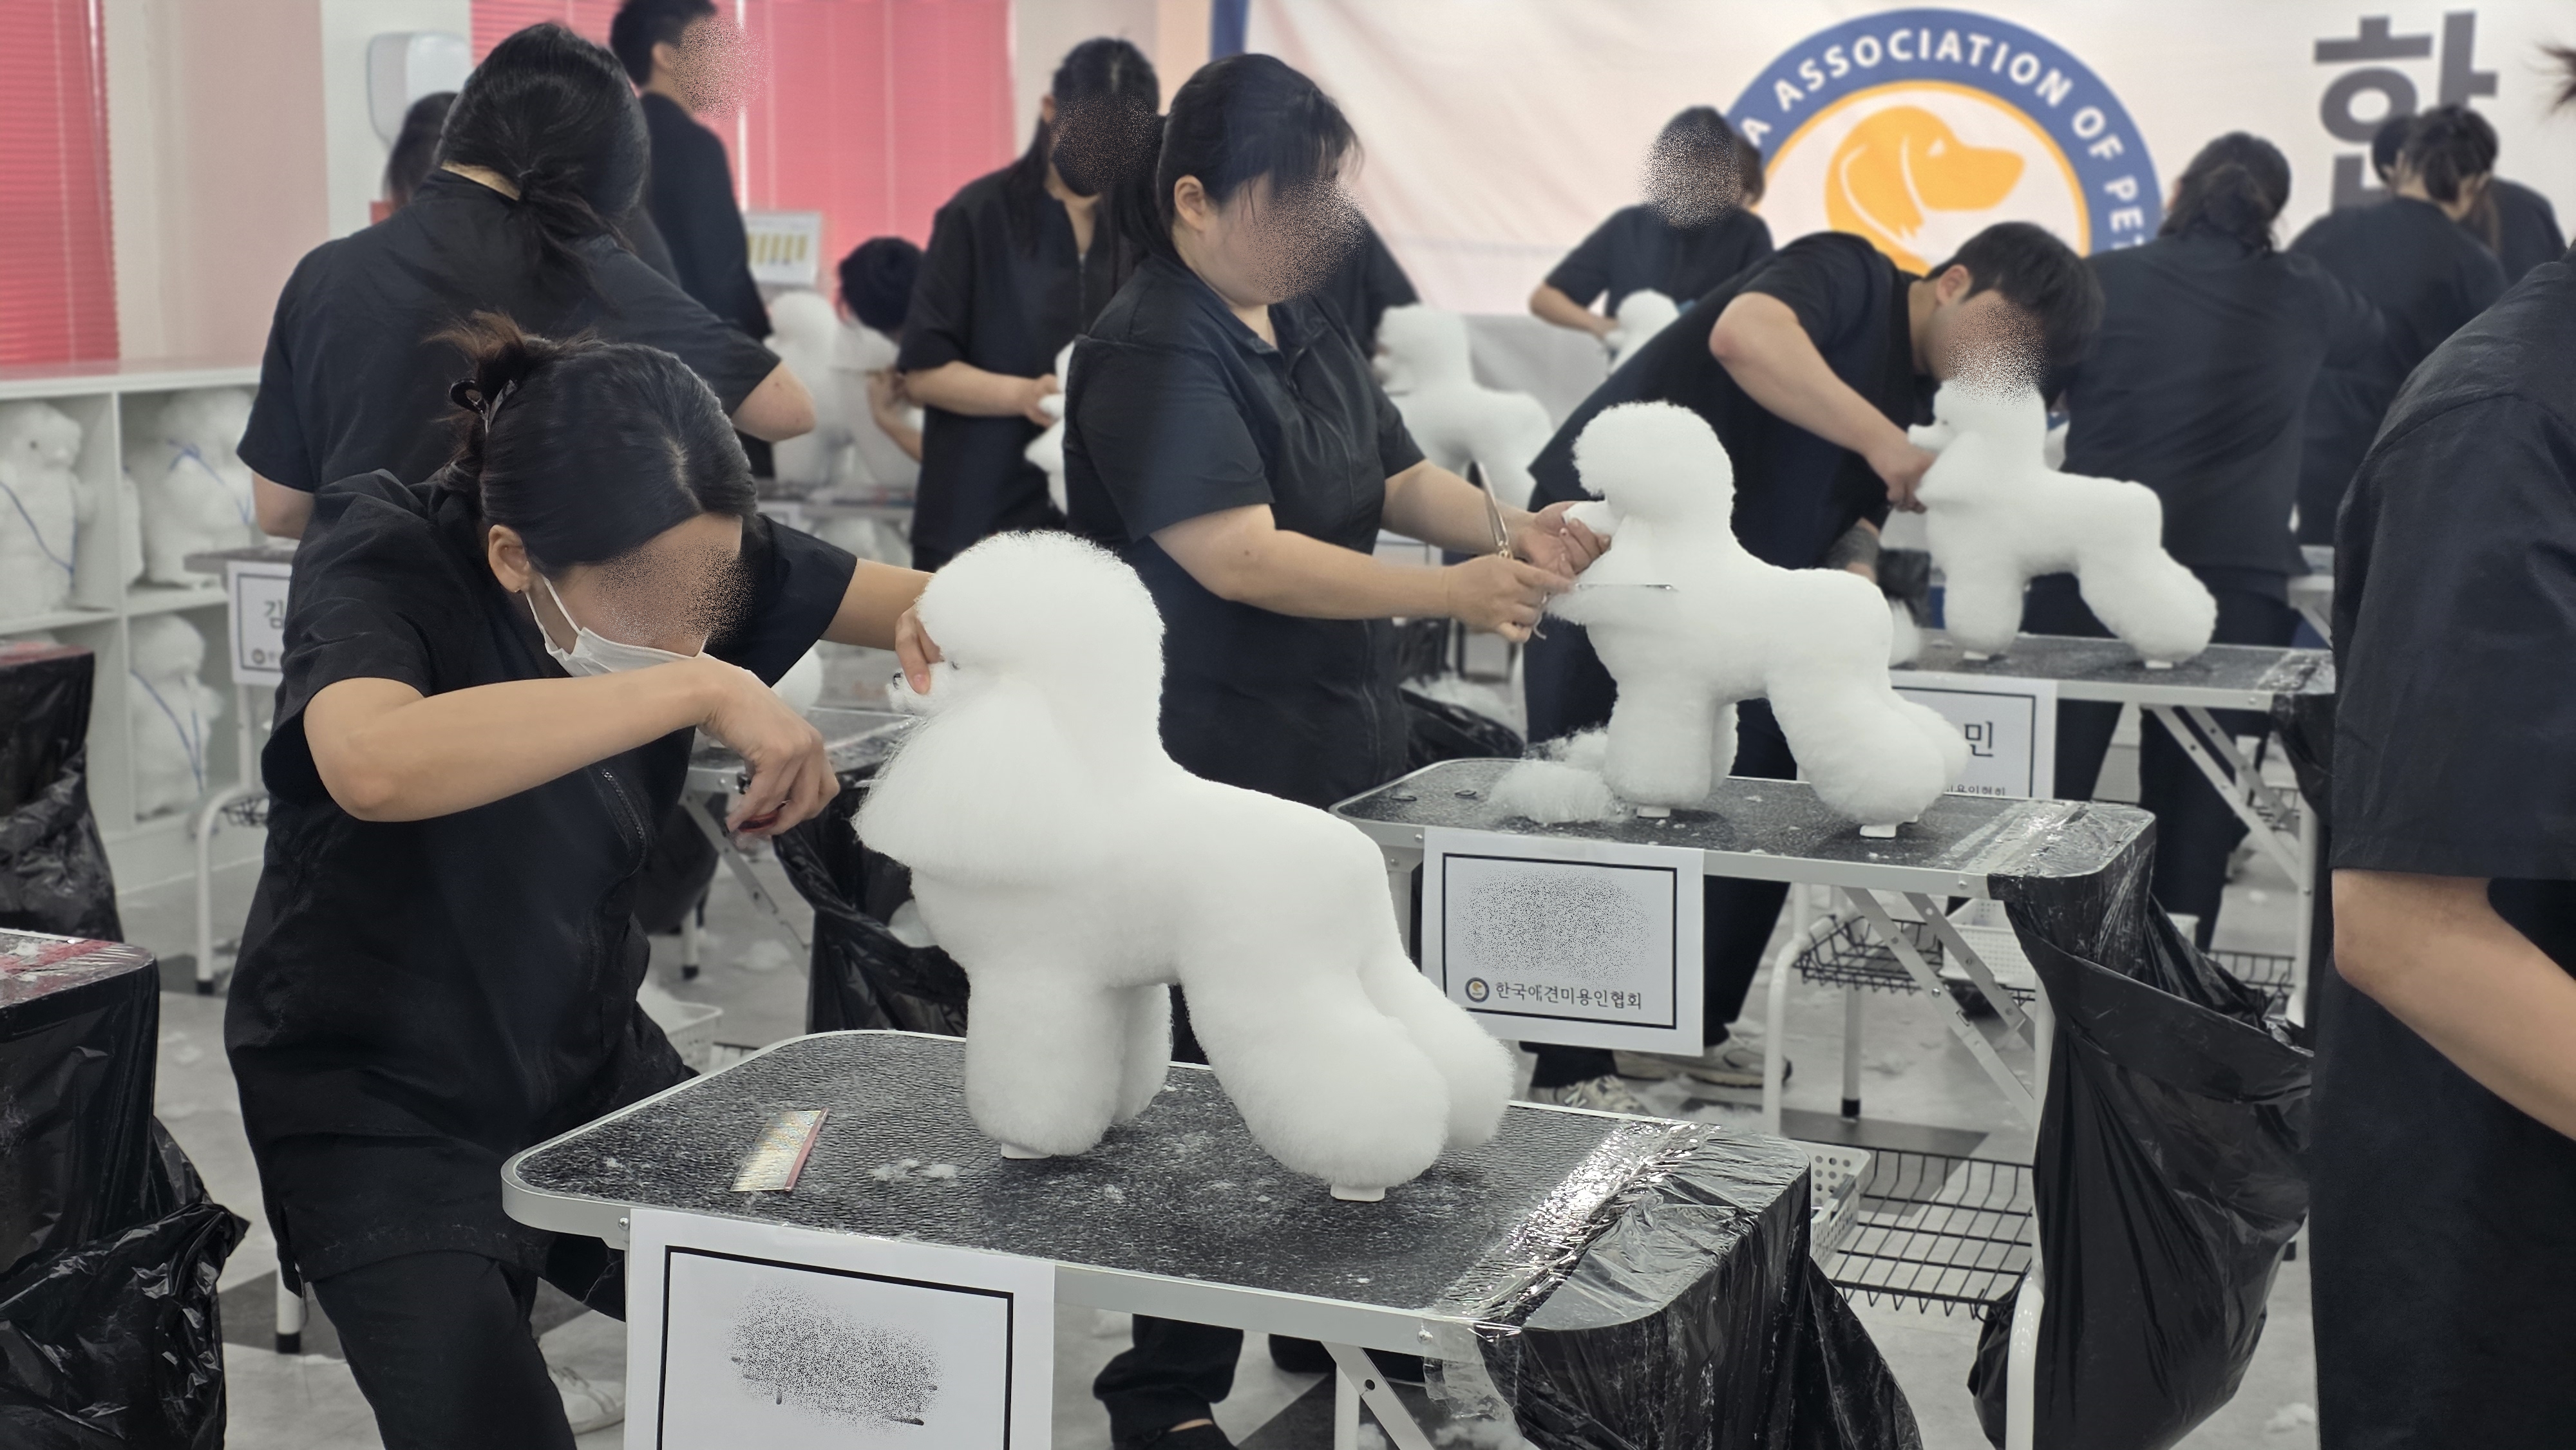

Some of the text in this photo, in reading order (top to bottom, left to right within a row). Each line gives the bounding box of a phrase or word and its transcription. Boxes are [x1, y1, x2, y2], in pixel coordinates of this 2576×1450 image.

[1774, 29, 2072, 111] ASSOCIATION
[2072, 107, 2124, 162] OF
[2103, 174, 2143, 250] PE
[1495, 982, 1642, 1010] 한국애견미용인협회
